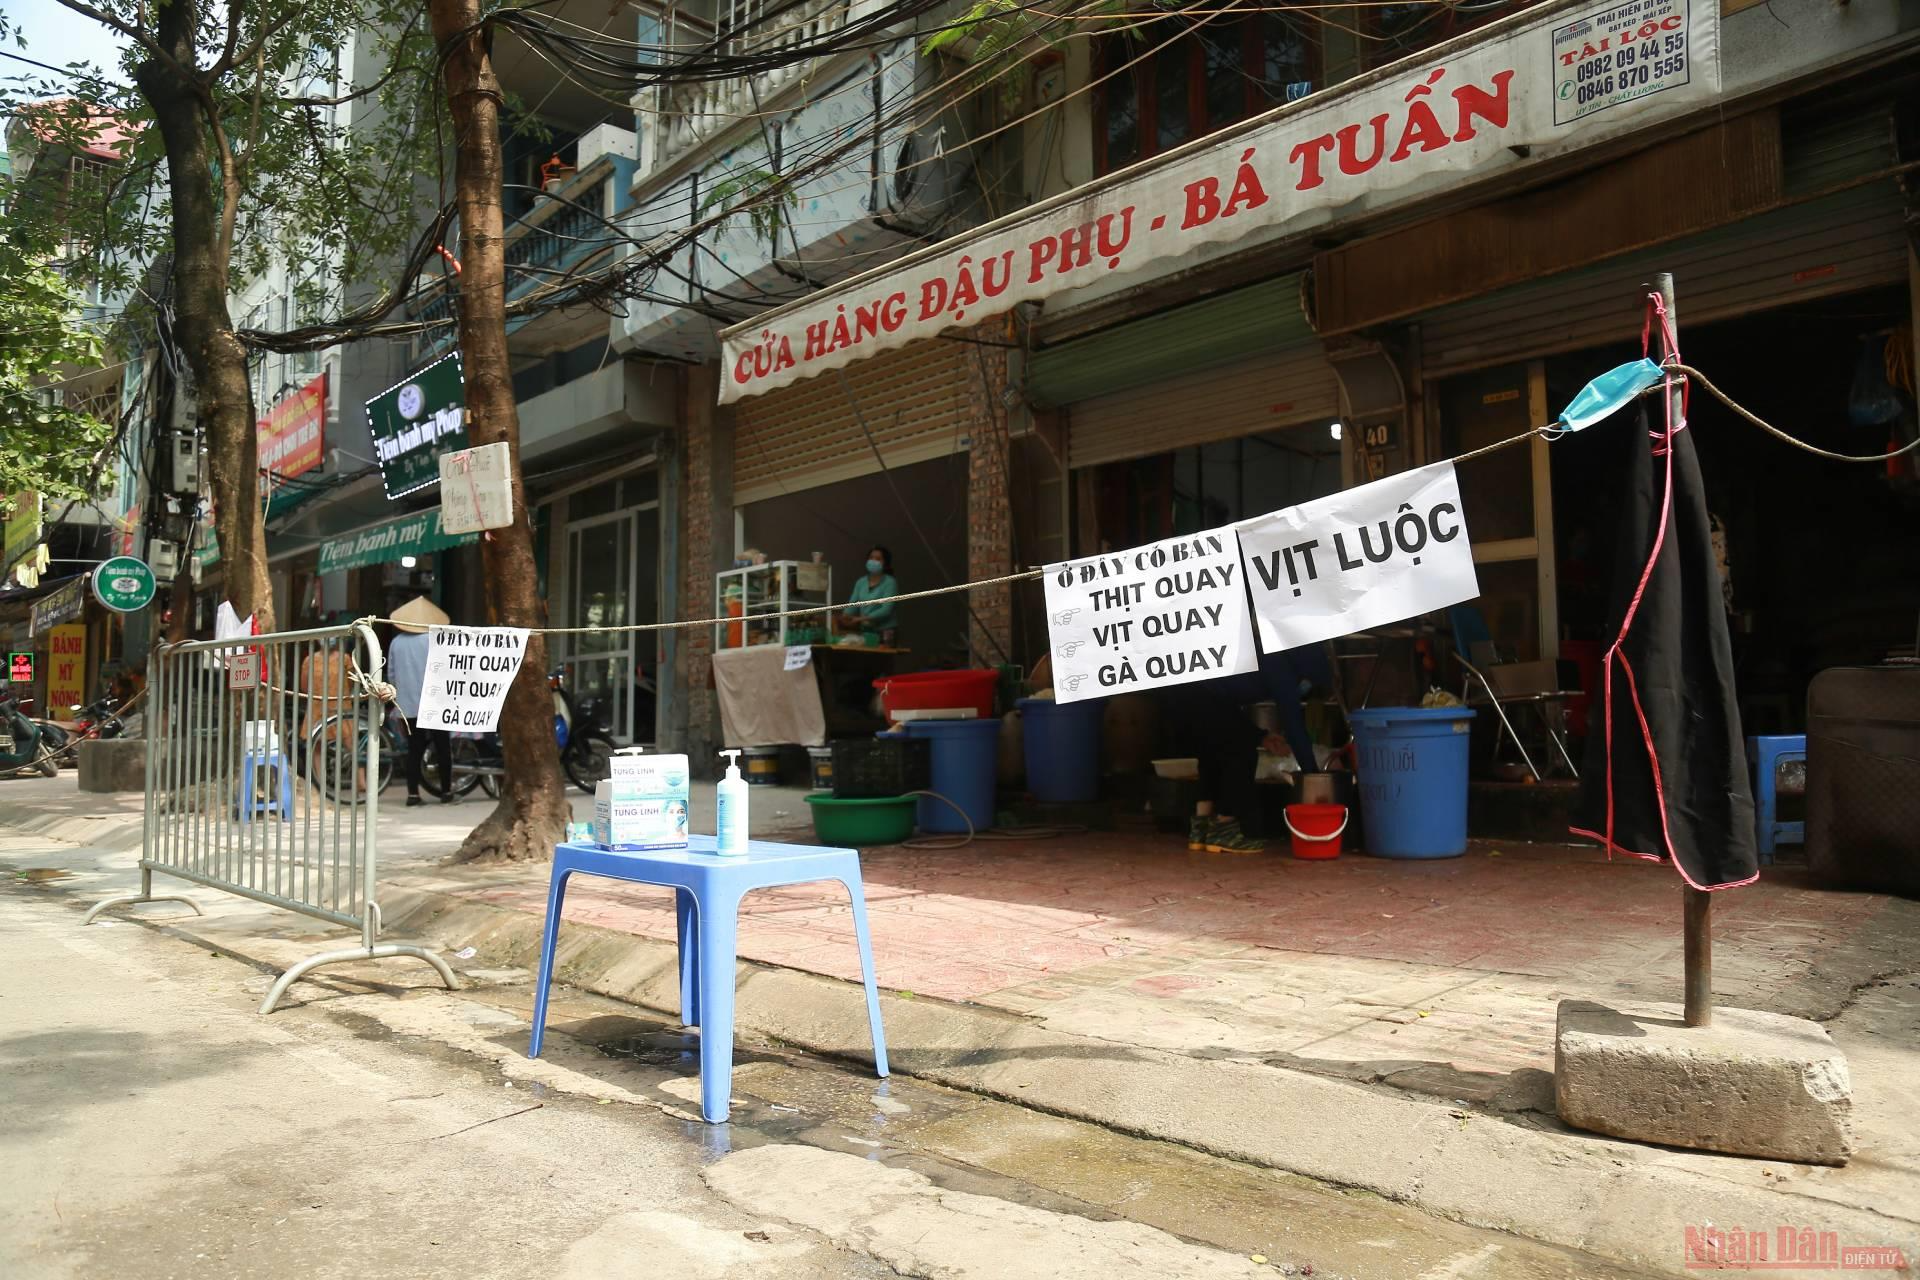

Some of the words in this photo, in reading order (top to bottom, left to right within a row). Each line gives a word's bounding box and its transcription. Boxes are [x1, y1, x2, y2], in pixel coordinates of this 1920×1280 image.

[1597, 12, 1615, 26] MÁI
[1559, 38, 1610, 66] TÀI
[1620, 15, 1682, 45] LỘC
[1577, 54, 1612, 83] 0982
[1616, 46, 1635, 68] 09
[1640, 39, 1660, 61] 44
[1665, 31, 1684, 54] 55
[1577, 75, 1613, 104] 0846
[1618, 65, 1649, 90] 870
[1654, 52, 1684, 79] 555
[733, 328, 796, 384] CỬA
[803, 292, 908, 361] HÀNG
[918, 250, 1016, 321] ĐẬU
[1027, 206, 1136, 283] PHỤ
[1181, 147, 1270, 230] BÁ
[1288, 68, 1515, 191] TUẤN
[1366, 425, 1388, 446] 40
[321, 538, 352, 566] Tiệm
[355, 525, 397, 554] bánh
[1057, 563, 1074, 588] Ở
[1079, 556, 1127, 584] ĐÂY
[1172, 534, 1224, 562] BÁN
[1251, 539, 1320, 597] VỊT
[1333, 502, 1460, 571] LUỘC
[1089, 582, 1146, 612] THỊT
[1155, 563, 1235, 598] QUAY
[1092, 620, 1134, 651] VỊT
[1142, 603, 1224, 638] QUAY
[53, 632, 82, 654] BÁNH
[235, 669, 251, 681] STOP
[449, 654, 476, 675] THỊT
[479, 655, 521, 672] QUAY
[1097, 656, 1138, 687] GÀ
[1145, 645, 1227, 679] QUAY
[51, 686, 80, 707] NÓNG
[446, 680, 466, 700] VỊT
[469, 681, 505, 698] QUAY
[441, 705, 459, 725] GÀ
[464, 709, 494, 726] QUAY
[637, 767, 655, 776] LINH
[640, 808, 659, 816] LINH
